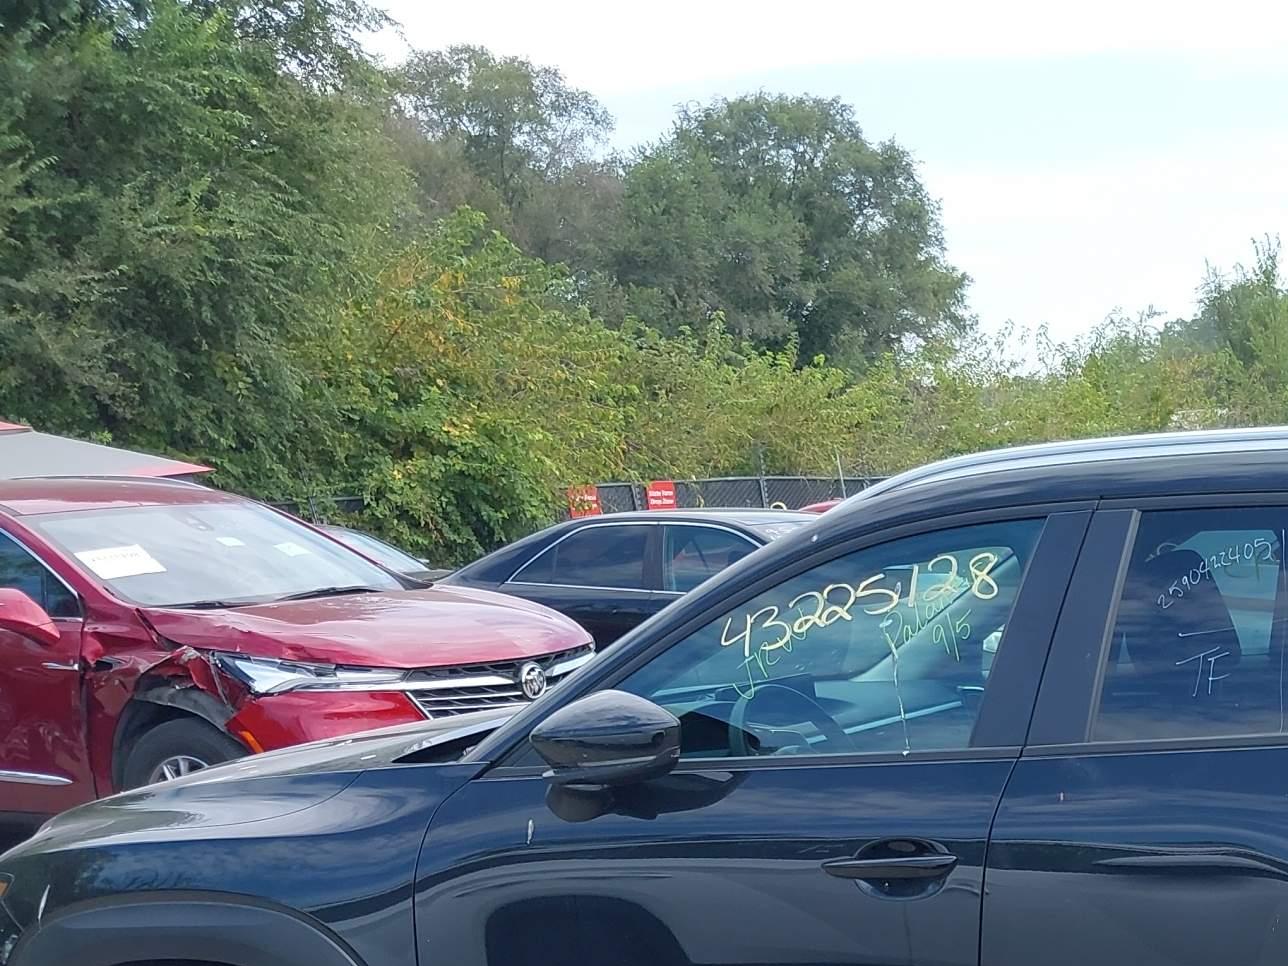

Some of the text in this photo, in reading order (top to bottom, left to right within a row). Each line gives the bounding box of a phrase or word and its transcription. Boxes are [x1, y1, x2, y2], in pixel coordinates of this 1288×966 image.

[720, 552, 999, 657] 43225128
[933, 609, 971, 662] 9/5
[1175, 646, 1230, 697] TF
